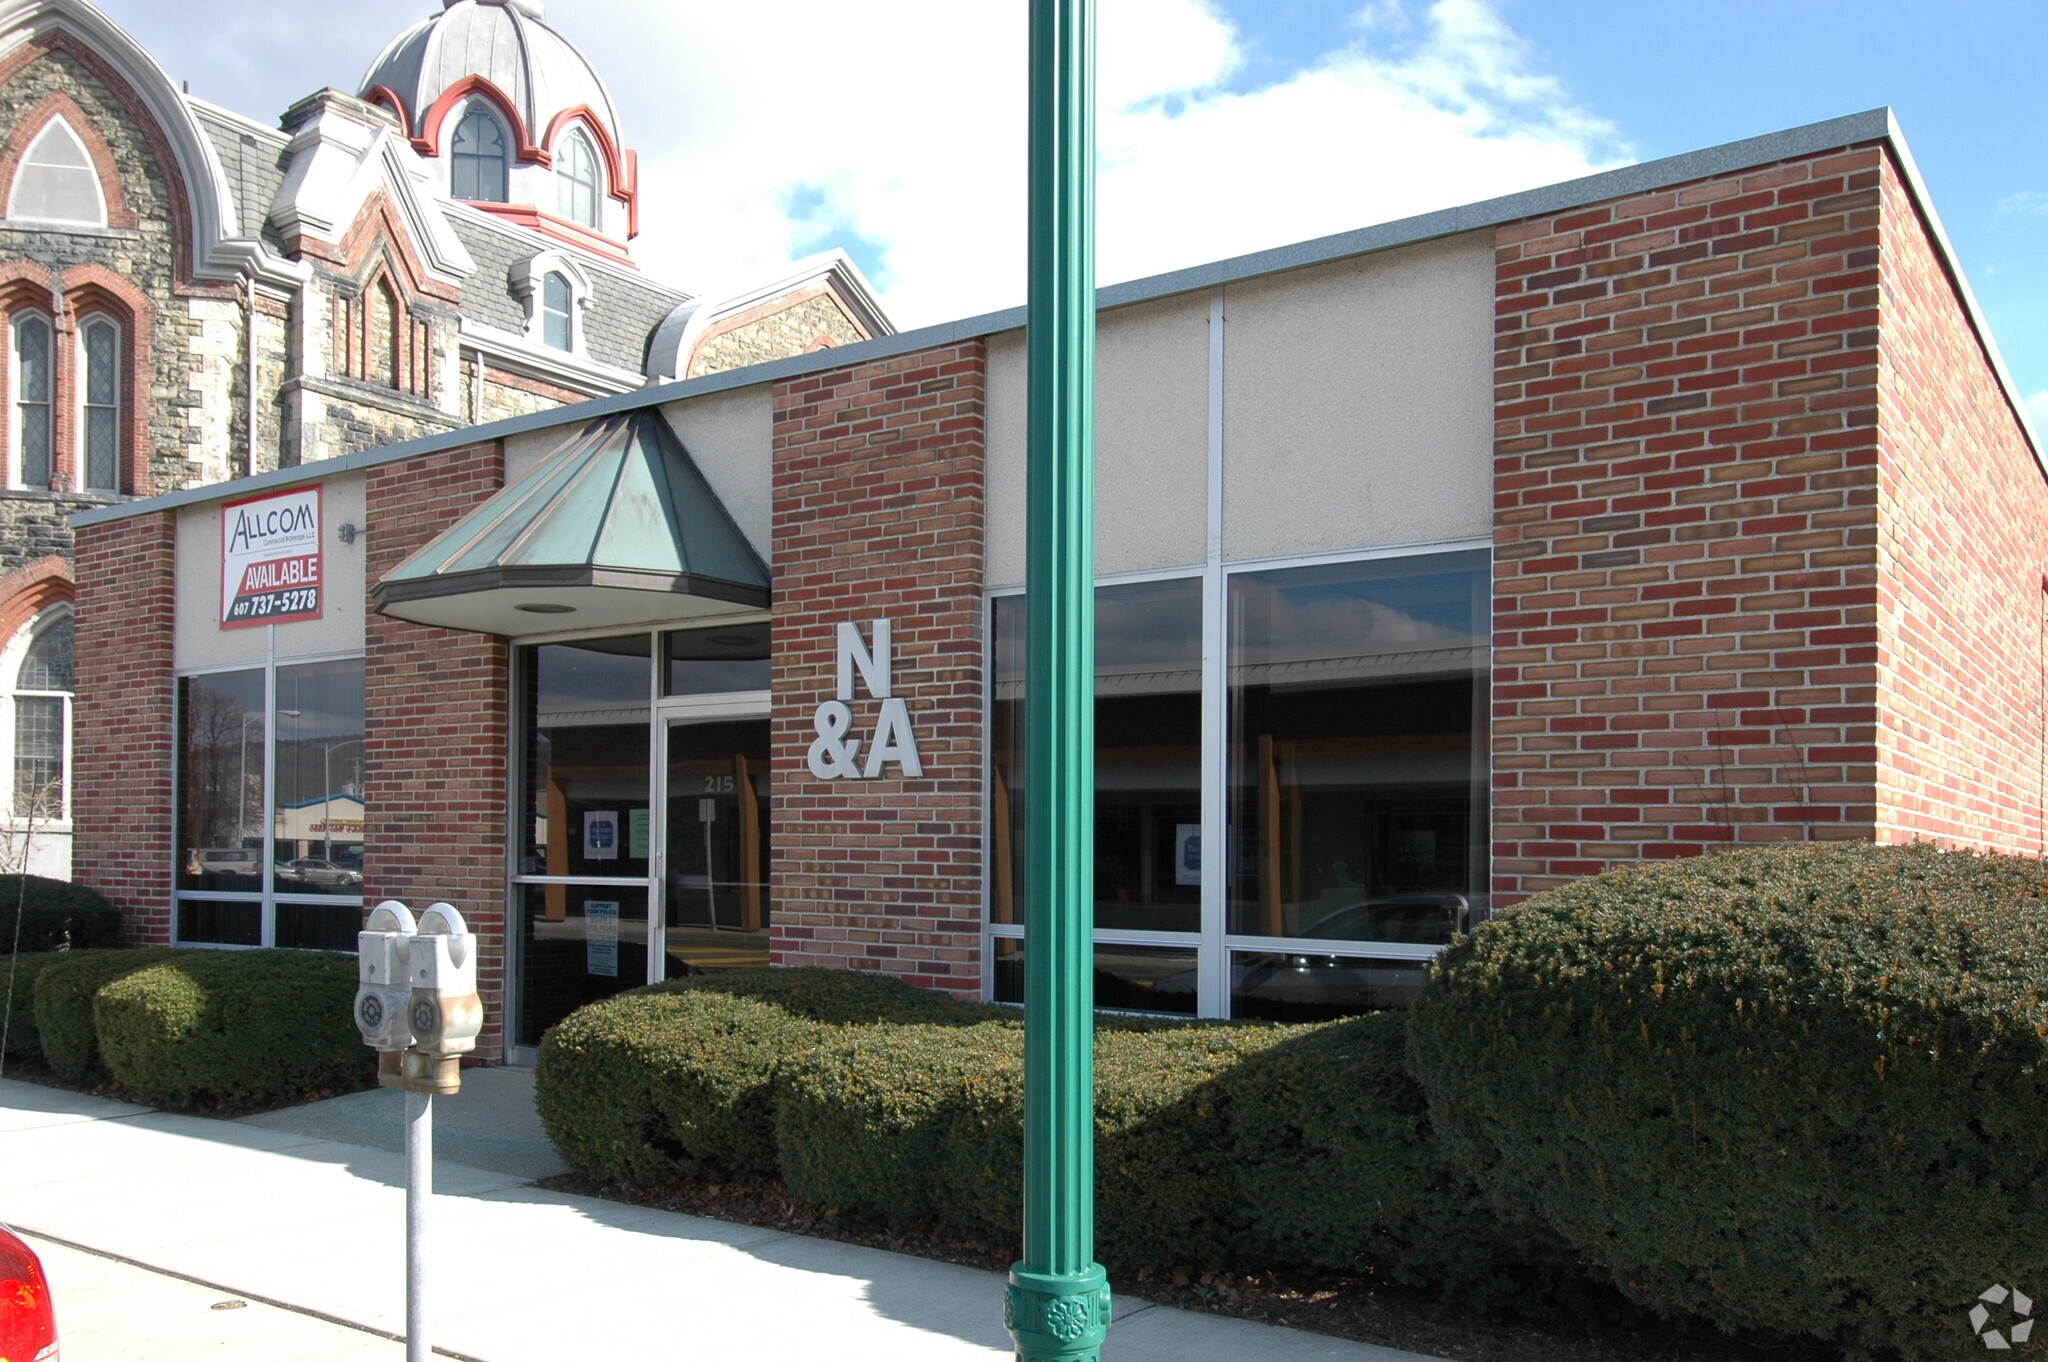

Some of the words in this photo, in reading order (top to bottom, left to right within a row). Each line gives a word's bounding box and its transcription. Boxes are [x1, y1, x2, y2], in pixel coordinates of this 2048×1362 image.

[229, 504, 315, 553] ALLCOM
[245, 557, 318, 591] AVAILABLE
[233, 602, 249, 616] 607
[250, 588, 317, 616] 737-5278
[837, 618, 891, 700] N
[704, 775, 734, 793] 215
